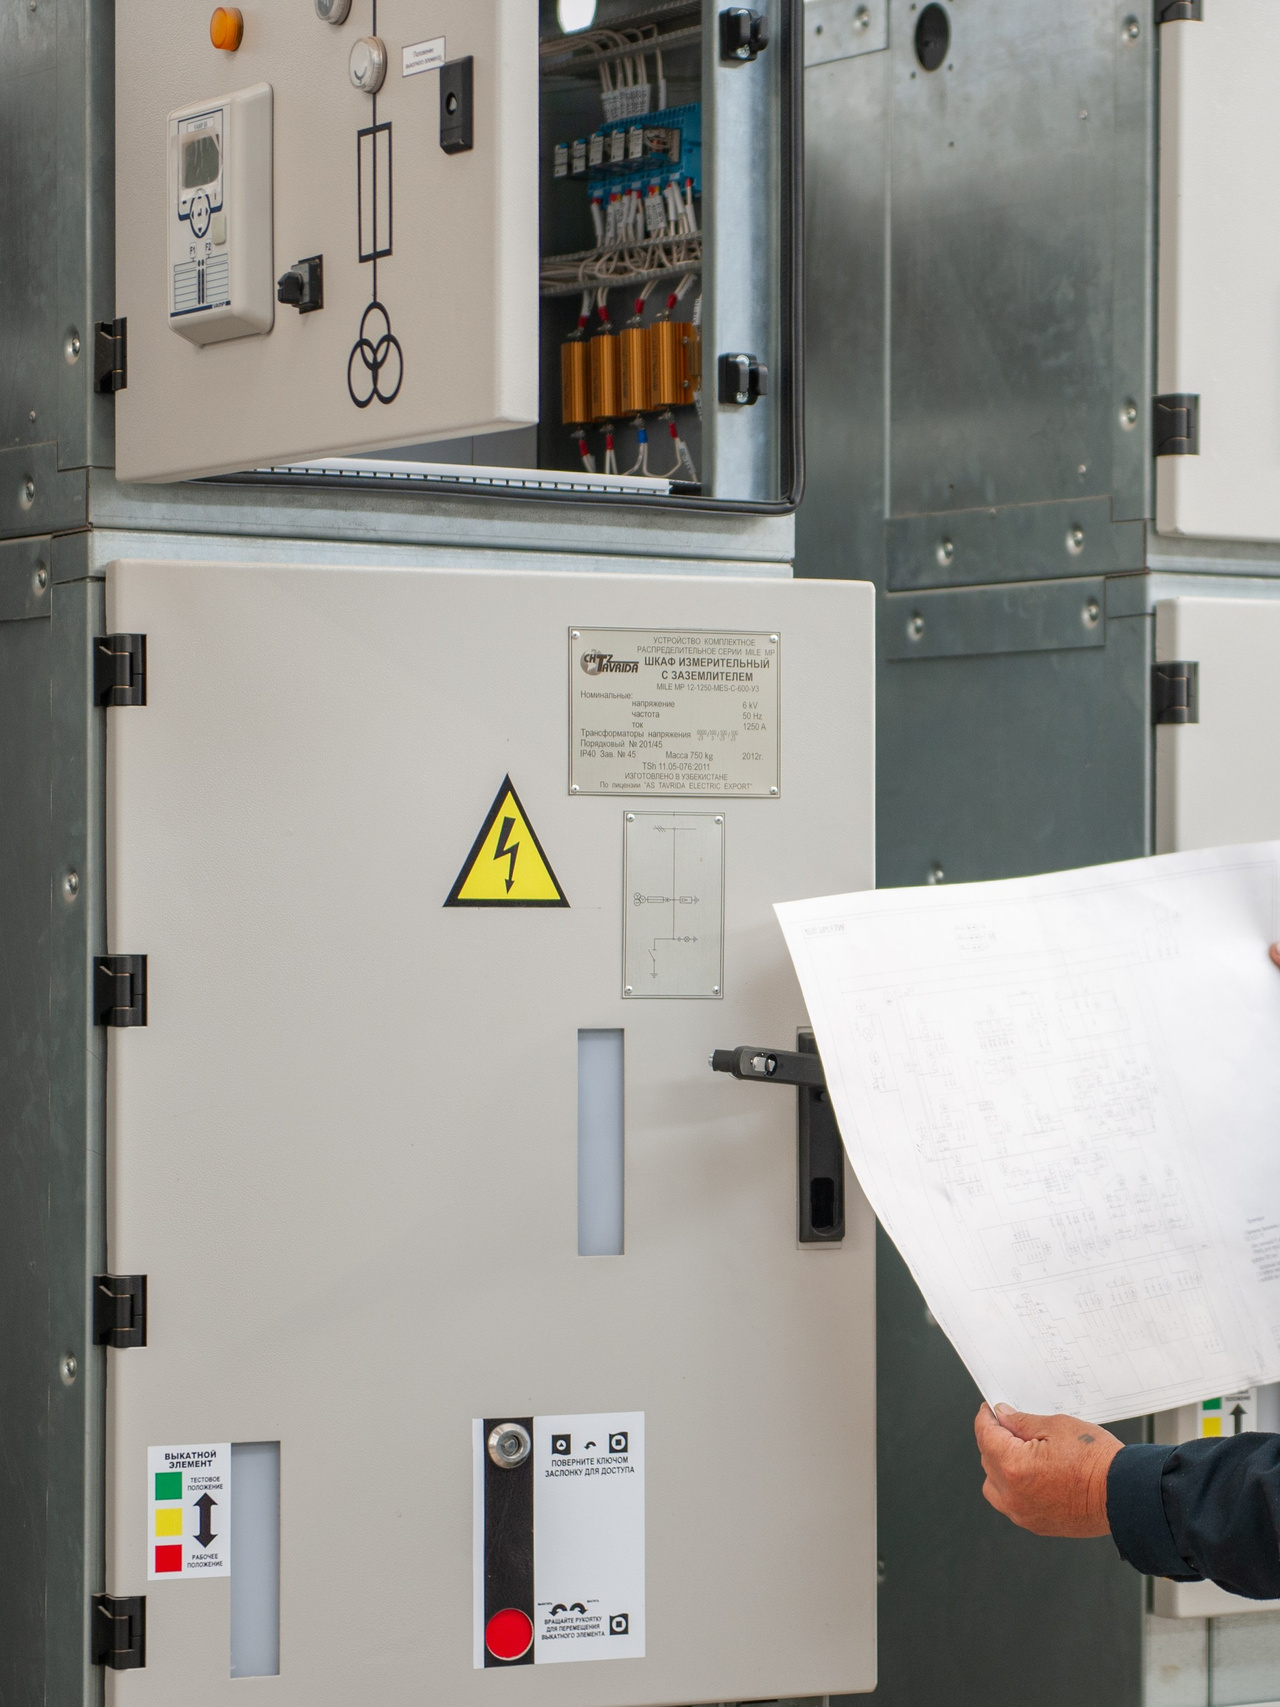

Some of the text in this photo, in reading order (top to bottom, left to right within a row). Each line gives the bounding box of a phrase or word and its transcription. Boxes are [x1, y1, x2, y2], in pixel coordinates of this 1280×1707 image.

[190, 242, 211, 254] F1 F2
[653, 637, 755, 646] УСТРОЙСТВО КОМПЛЕКТНОЕ
[637, 646, 716, 655] РАСПРЕДЕЛИТЕЛЬНОЕ
[645, 657, 770, 668] ШКАФ ИЗМЕРИТЕЛЬНЫЙ
[662, 671, 753, 682] С ЗАЗЕМЛИТЕЛЕМ
[581, 691, 633, 699] Номинальные:
[632, 701, 675, 709] напряжение
[581, 729, 644, 738] Трансформаторы
[648, 731, 691, 739] напряжения
[580, 739, 624, 748] Порядковый
[639, 740, 662, 748] 201/45
[704, 752, 713, 761] kg
[742, 753, 763, 761] 2012г.
[625, 772, 674, 780] ИЗГОТОВЛЕНО
[682, 773, 727, 781] УЗБЕКИСТАНЕ
[165, 1450, 216, 1460] ВЫКАТНОЙ
[169, 1460, 212, 1469] ЭЛЕМЕНТ
[552, 1456, 628, 1467] ПОВЕРНИТЕ КЛЮЧОМ
[545, 1466, 634, 1477] ЗАСЛОНКУ ДЛЯ ДОСТУПА
[544, 1617, 574, 1625] ВРАЩАЙТЕ
